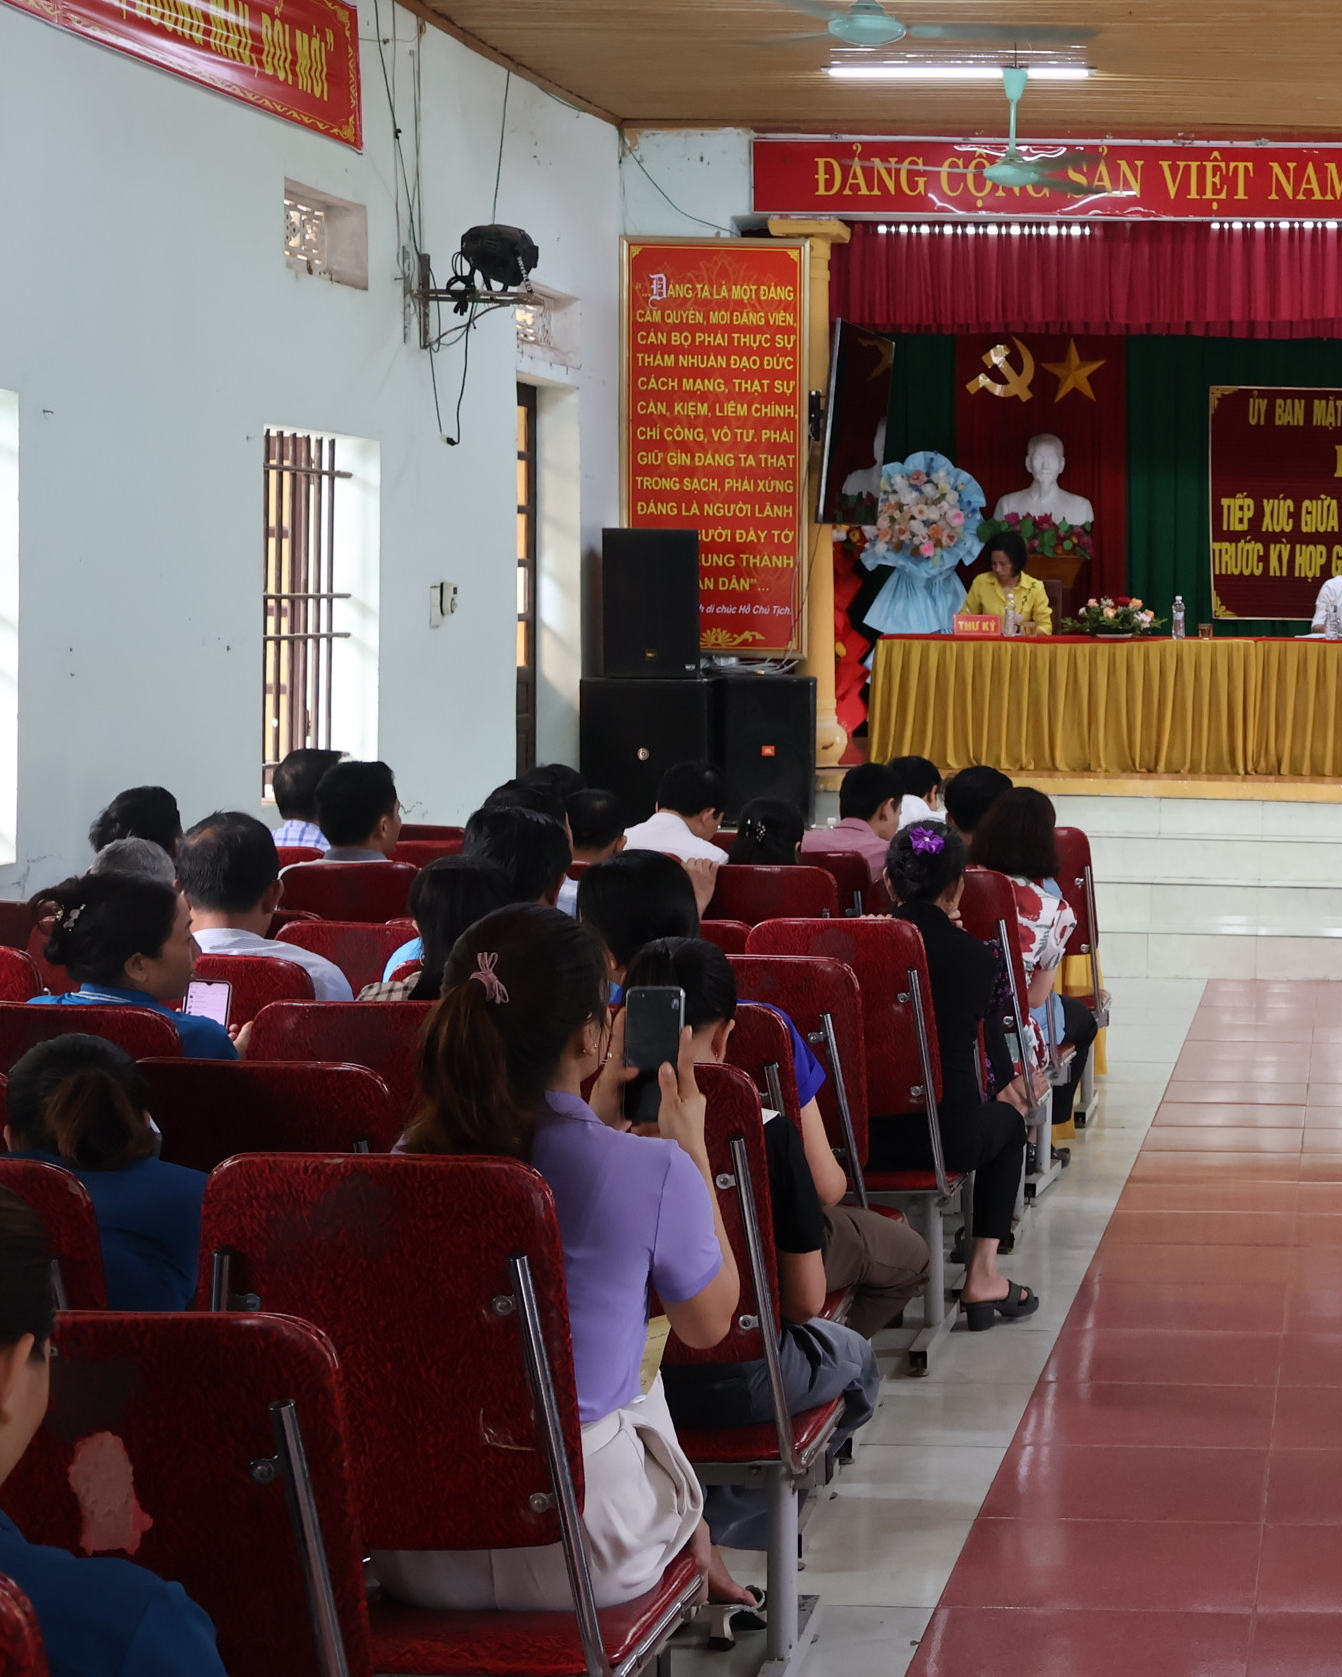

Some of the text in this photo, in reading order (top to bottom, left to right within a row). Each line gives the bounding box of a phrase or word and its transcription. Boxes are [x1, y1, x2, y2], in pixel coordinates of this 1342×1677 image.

[814, 143, 927, 196] ĐẢNG
[1068, 145, 1144, 198] SẢN
[1159, 151, 1254, 211] VIỆT
[697, 281, 794, 303] TA LÀ MỘT ĐẢNG
[637, 307, 796, 327] CẦM QUYỀN, MỖI ĐẢNG VIÊN,
[638, 329, 796, 351] CÁN BỘ PHẢI THỰC SỰ
[679, 353, 726, 368] NHUẦN
[731, 355, 759, 372] ĐẠO
[764, 354, 794, 370] ĐỨC
[638, 375, 795, 396] CÁCH MẠNG, THẬT SỰ
[638, 399, 797, 419] CẦN, KIỆM, LIÊM CHÍNH,
[1249, 391, 1268, 425] ỦY
[1275, 399, 1304, 426] BAN
[637, 426, 793, 443] CHÍ CÔNG, VÔ TƯ. PHẢI
[638, 451, 795, 471] GIỮ GÌN ĐẢNG TA THẬT
[636, 476, 794, 494] TRONG SẠCH, PHẢI XỨNG
[637, 499, 793, 517] ĐÁNG LÀ NGƯỜI LÃNH
[1221, 492, 1254, 531] TIẾP
[1262, 494, 1294, 532] XÚC
[736, 527, 795, 543] ĐẦY TỚ
[740, 552, 794, 568] THÀNH
[1213, 536, 1263, 575] TRƯỚC
[1269, 540, 1291, 577] KỲ
[1295, 544, 1326, 582] HỌP
[706, 605, 714, 614] di
[716, 605, 737, 614] chúc
[739, 603, 751, 614] Hồ
[753, 605, 770, 614] Chủ
[773, 606, 792, 617] Tịch.
[958, 621, 979, 631] THƯ
